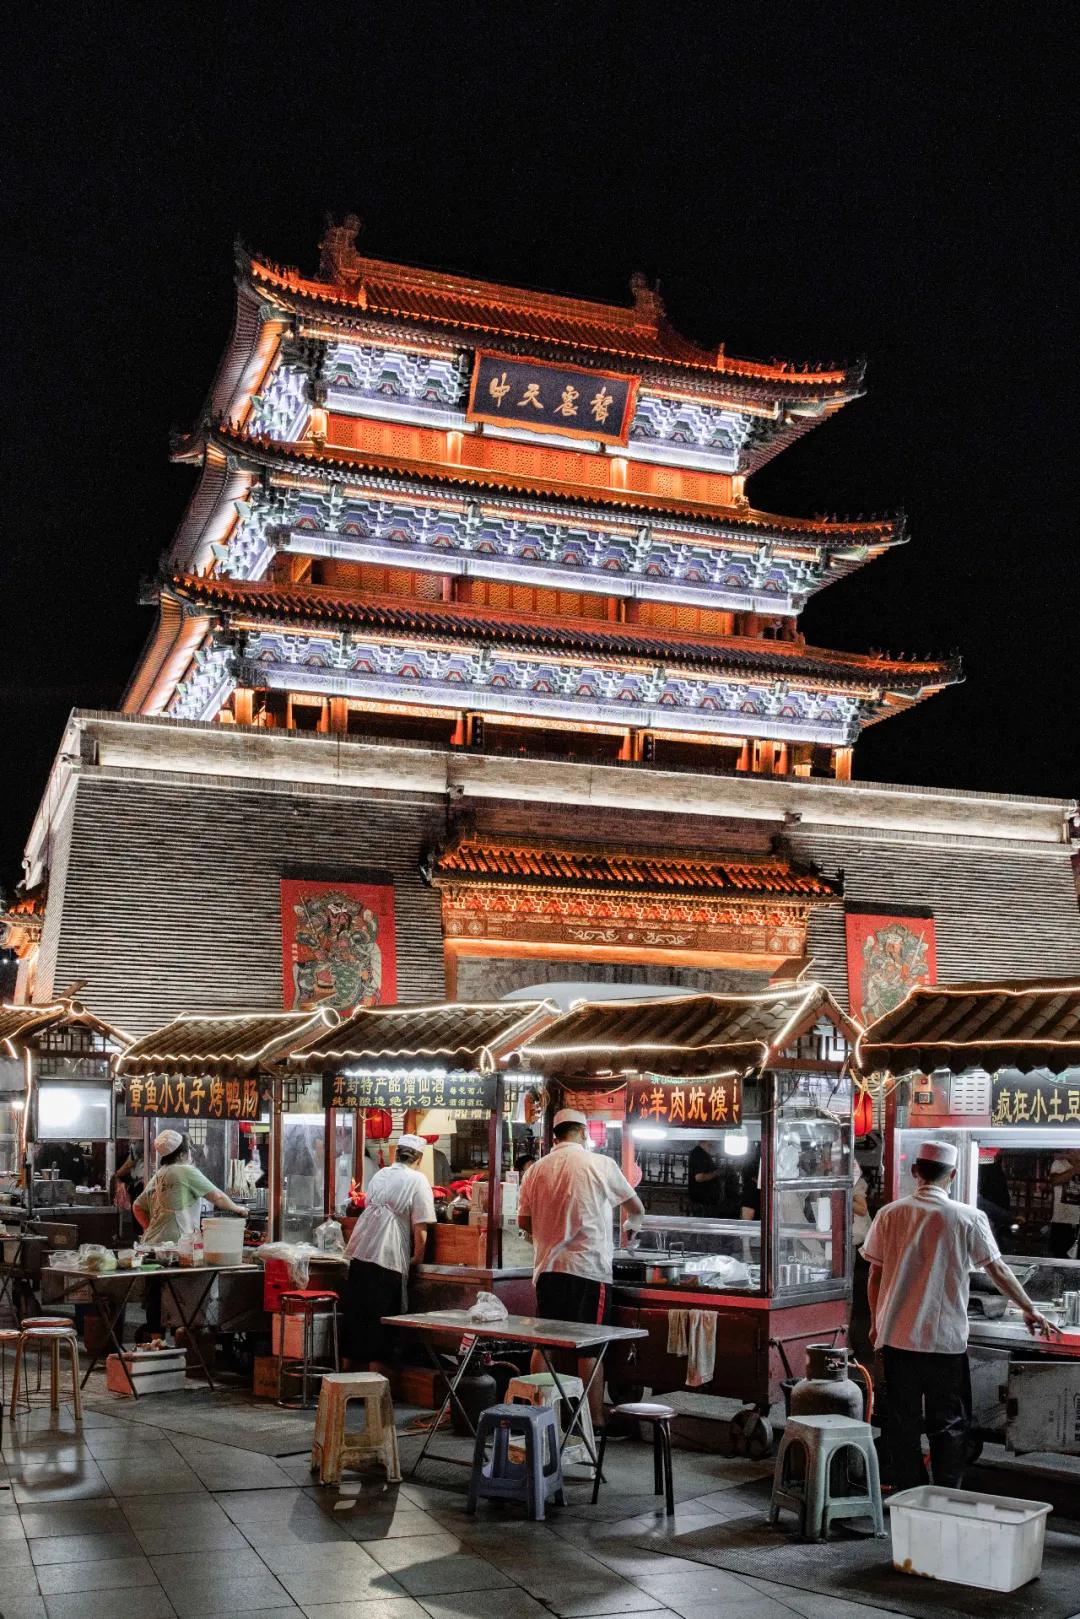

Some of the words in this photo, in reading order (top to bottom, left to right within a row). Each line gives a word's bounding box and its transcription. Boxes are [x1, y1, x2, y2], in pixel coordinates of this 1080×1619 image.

[998, 1088, 1080, 1123] 疯狂小土豆
